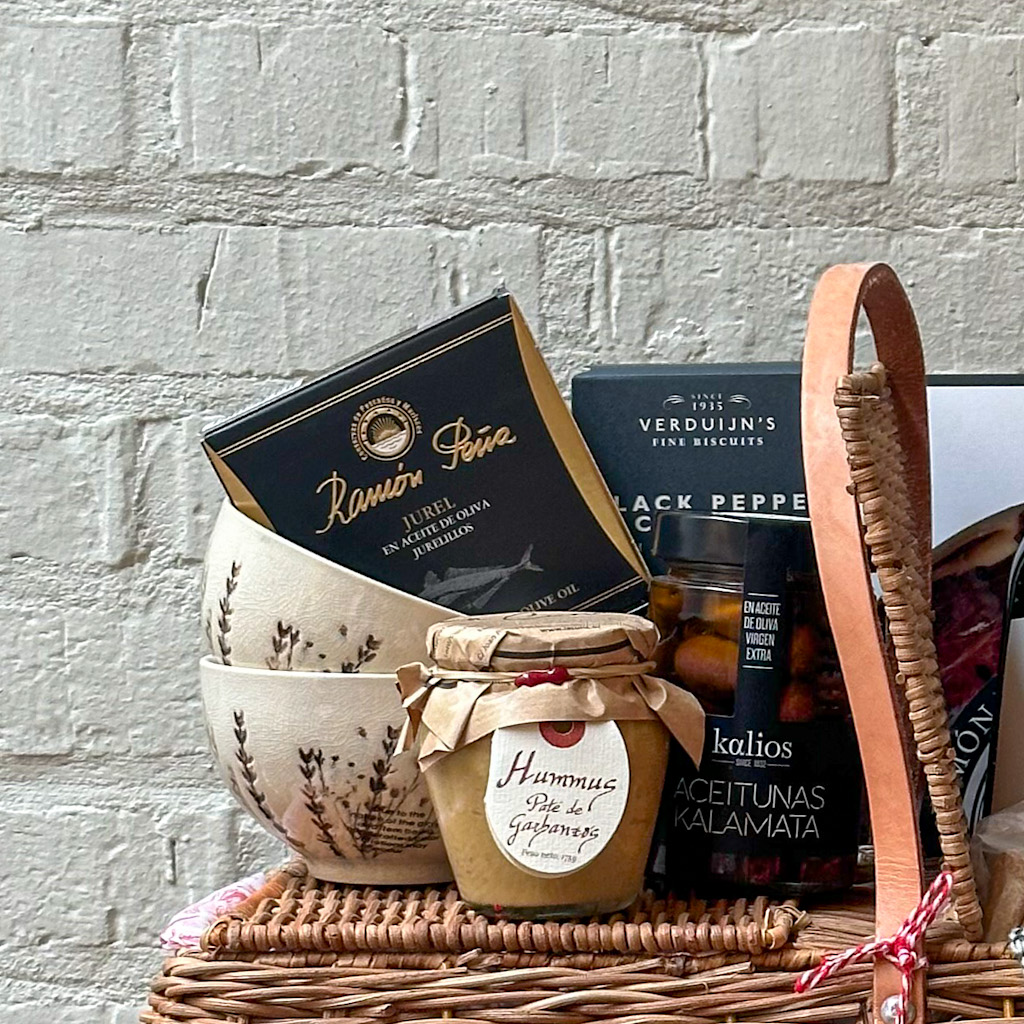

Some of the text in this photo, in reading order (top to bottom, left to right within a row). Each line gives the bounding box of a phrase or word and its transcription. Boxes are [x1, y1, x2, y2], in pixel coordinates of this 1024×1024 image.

[692, 401, 724, 411] 1935
[638, 416, 777, 432] VERDUIJN'S
[652, 436, 764, 447] FINE BISCUITS
[315, 416, 518, 534] Ramón Peña
[616, 493, 806, 512] LACK PEPPE
[401, 497, 456, 533] JUREL
[382, 499, 491, 556] EN ACEITE DE OLIVA
[412, 522, 475, 561] JURELILLOS
[556, 583, 581, 599] OIL
[743, 600, 781, 616] EN ACEITE
[743, 615, 778, 631] DE OLIVA
[745, 631, 775, 647] VIRGEN
[745, 647, 772, 662] EXTRA
[711, 727, 793, 760] kalios
[496, 750, 618, 812] Hummus
[673, 777, 826, 810] ACEITUNAS
[565, 798, 583, 815] de
[674, 806, 820, 840] KALAMATA
